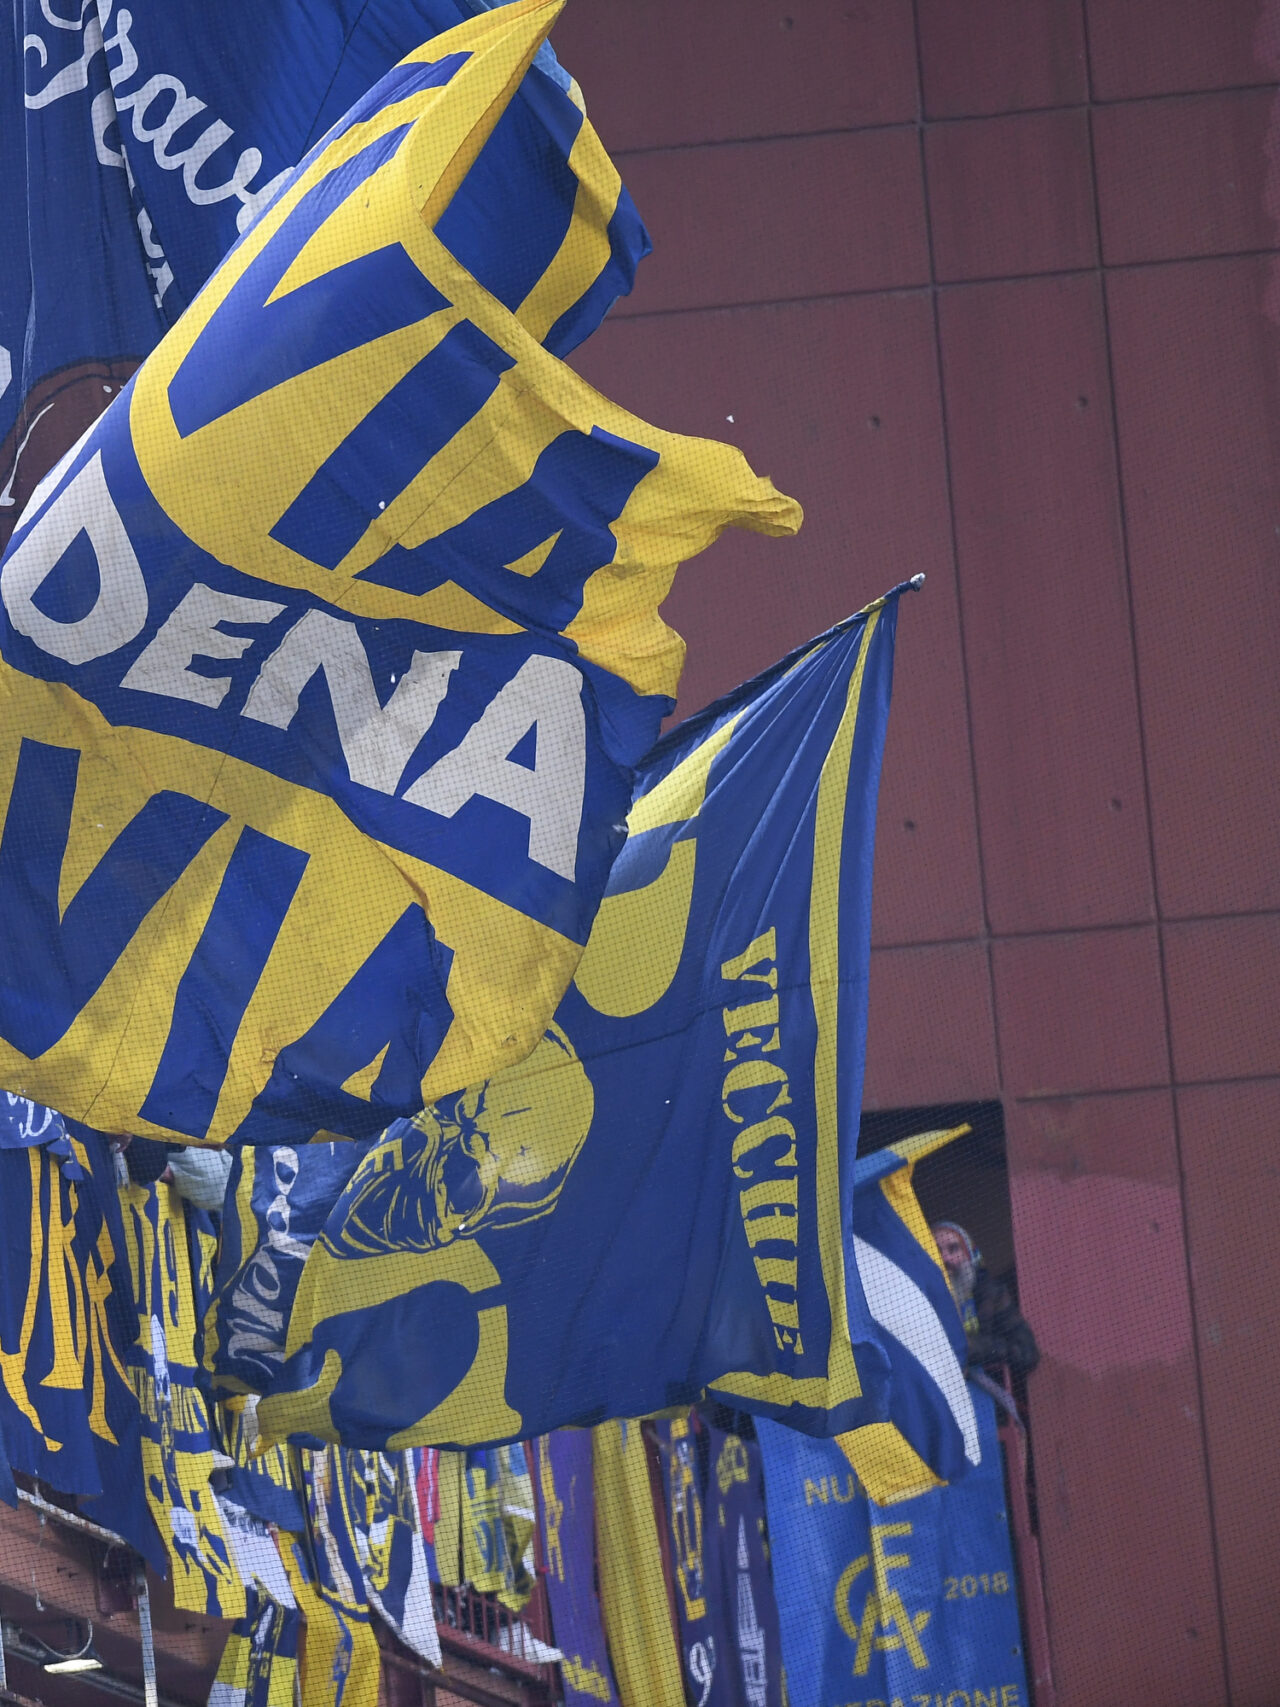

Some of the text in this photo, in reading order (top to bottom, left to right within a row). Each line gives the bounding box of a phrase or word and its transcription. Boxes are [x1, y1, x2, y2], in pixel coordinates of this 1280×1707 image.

[167, 90, 660, 637] VIA
[0, 430, 590, 884] DENA
[721, 926, 804, 1355] VECCHIE
[804, 1474, 867, 1507] NU
[944, 1570, 1010, 1600] 2018
